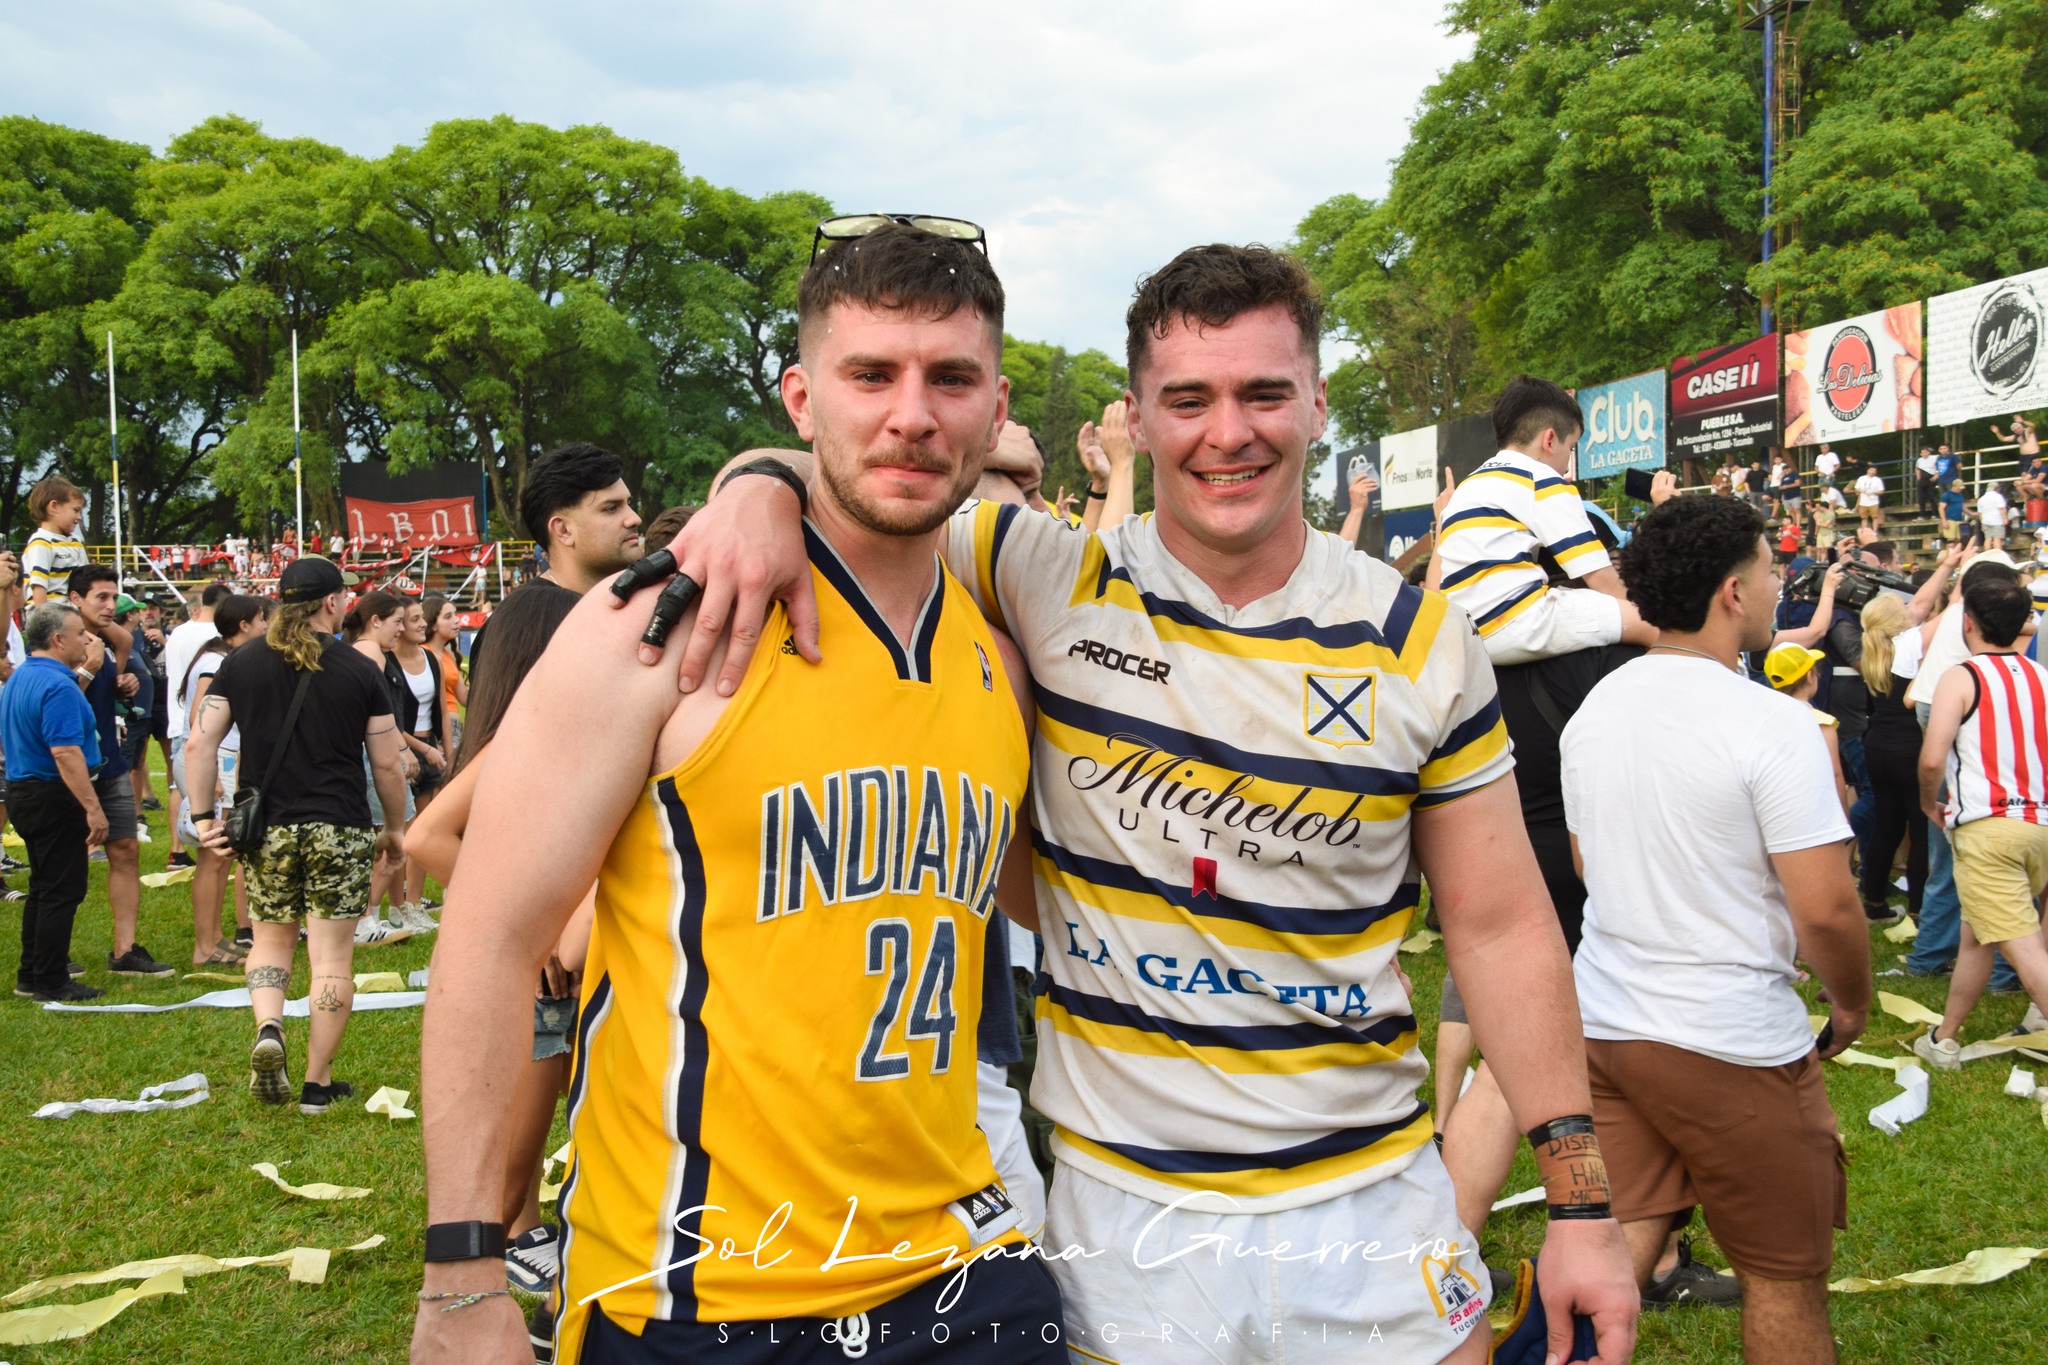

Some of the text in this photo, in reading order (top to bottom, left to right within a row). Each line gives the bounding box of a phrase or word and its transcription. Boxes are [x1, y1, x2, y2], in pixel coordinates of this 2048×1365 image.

[1978, 313, 2035, 370] Heller
[1687, 365, 1740, 399] CASE
[1816, 362, 1883, 394] Las Delicias
[1585, 389, 1657, 453] Club
[1590, 445, 1654, 469] LA GACETA
[1068, 639, 1171, 685] PROCER
[1068, 732, 1366, 847] Michelob
[1119, 808, 1305, 867] ULTRA
[855, 916, 957, 1083] 24
[1449, 1298, 1483, 1326] 25 años
